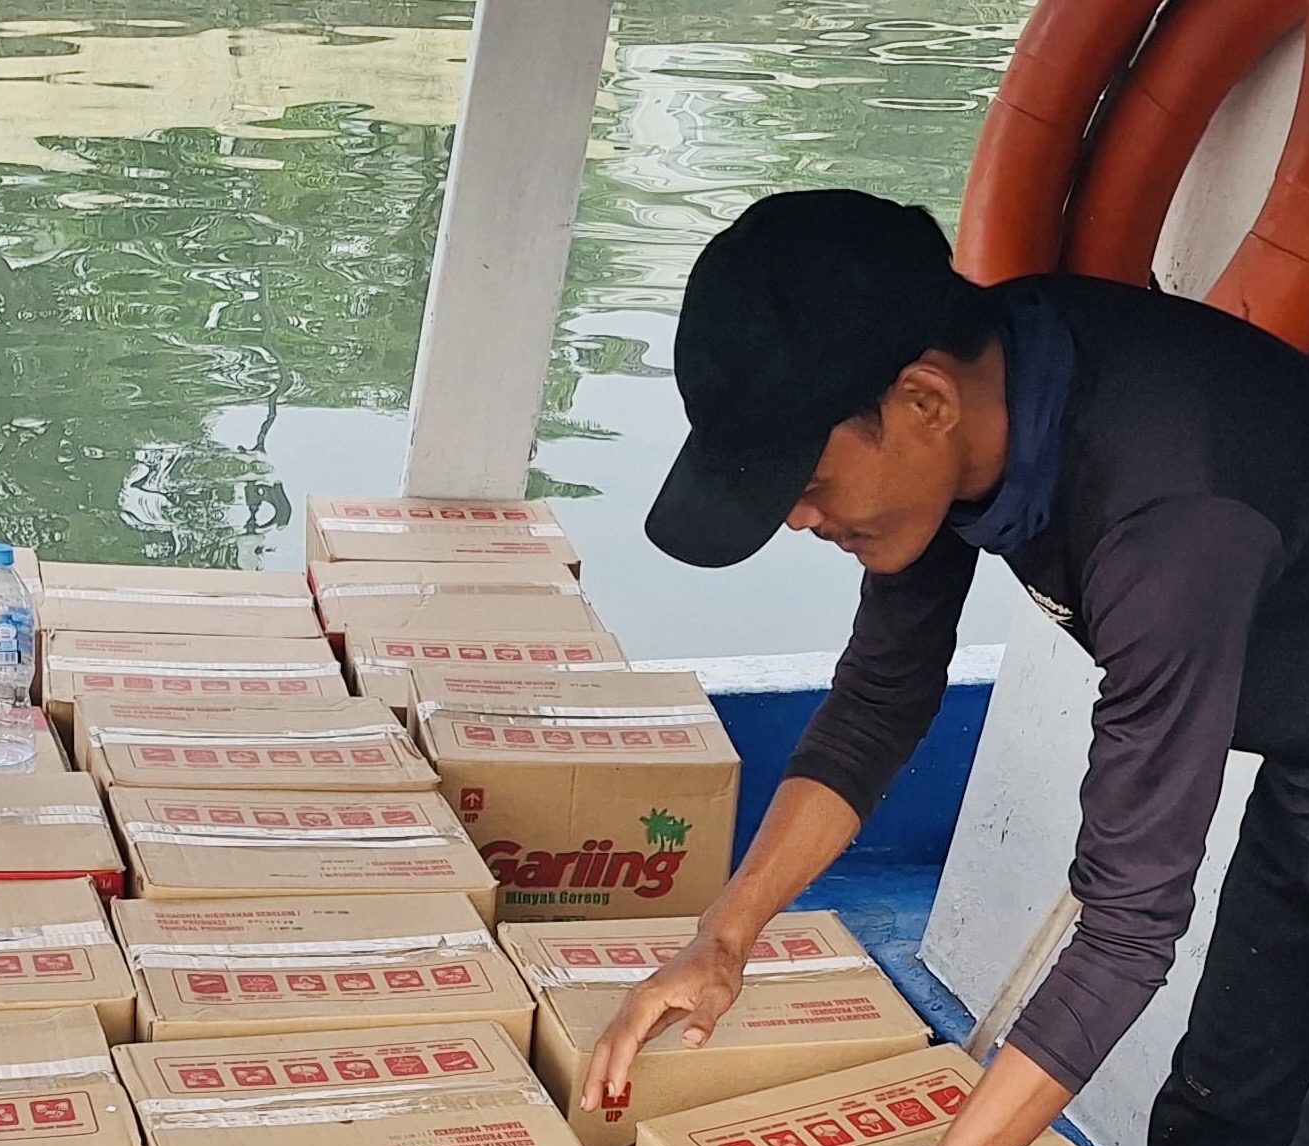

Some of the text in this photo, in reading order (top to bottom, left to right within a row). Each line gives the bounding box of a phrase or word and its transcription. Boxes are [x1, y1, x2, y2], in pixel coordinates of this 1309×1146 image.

[464, 813, 479, 823] UP
[505, 891, 558, 905] Minyak
[606, 1111, 622, 1122] UP
